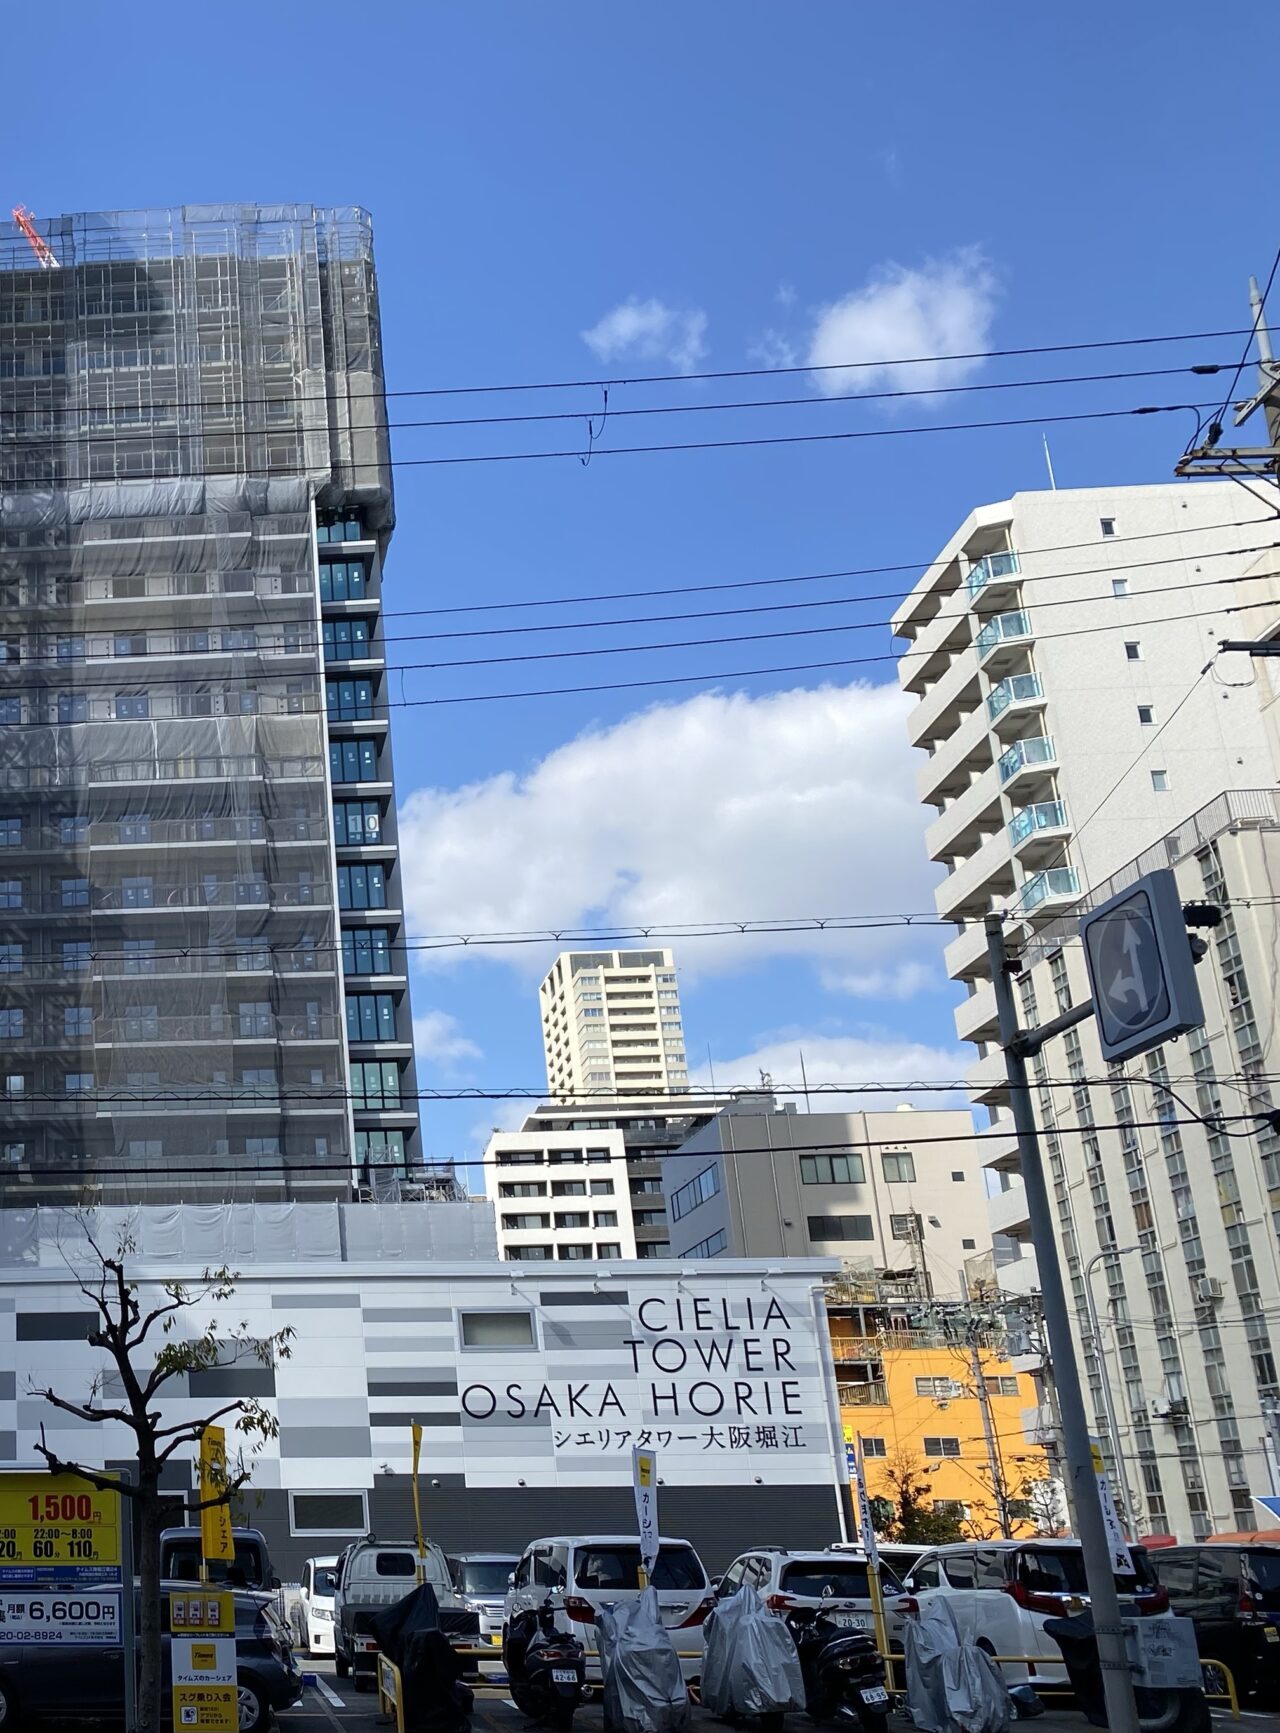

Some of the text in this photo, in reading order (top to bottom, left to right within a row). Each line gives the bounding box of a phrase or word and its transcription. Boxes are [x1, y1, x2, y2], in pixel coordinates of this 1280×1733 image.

[638, 1297, 792, 1332] CIELIA
[623, 1338, 797, 1374] TOWER
[461, 1381, 803, 1419] OSAKA HORIE
[554, 1425, 807, 1450] シエリアタワー大阪堀江
[7, 1601, 115, 1622] 月額 6,600円
